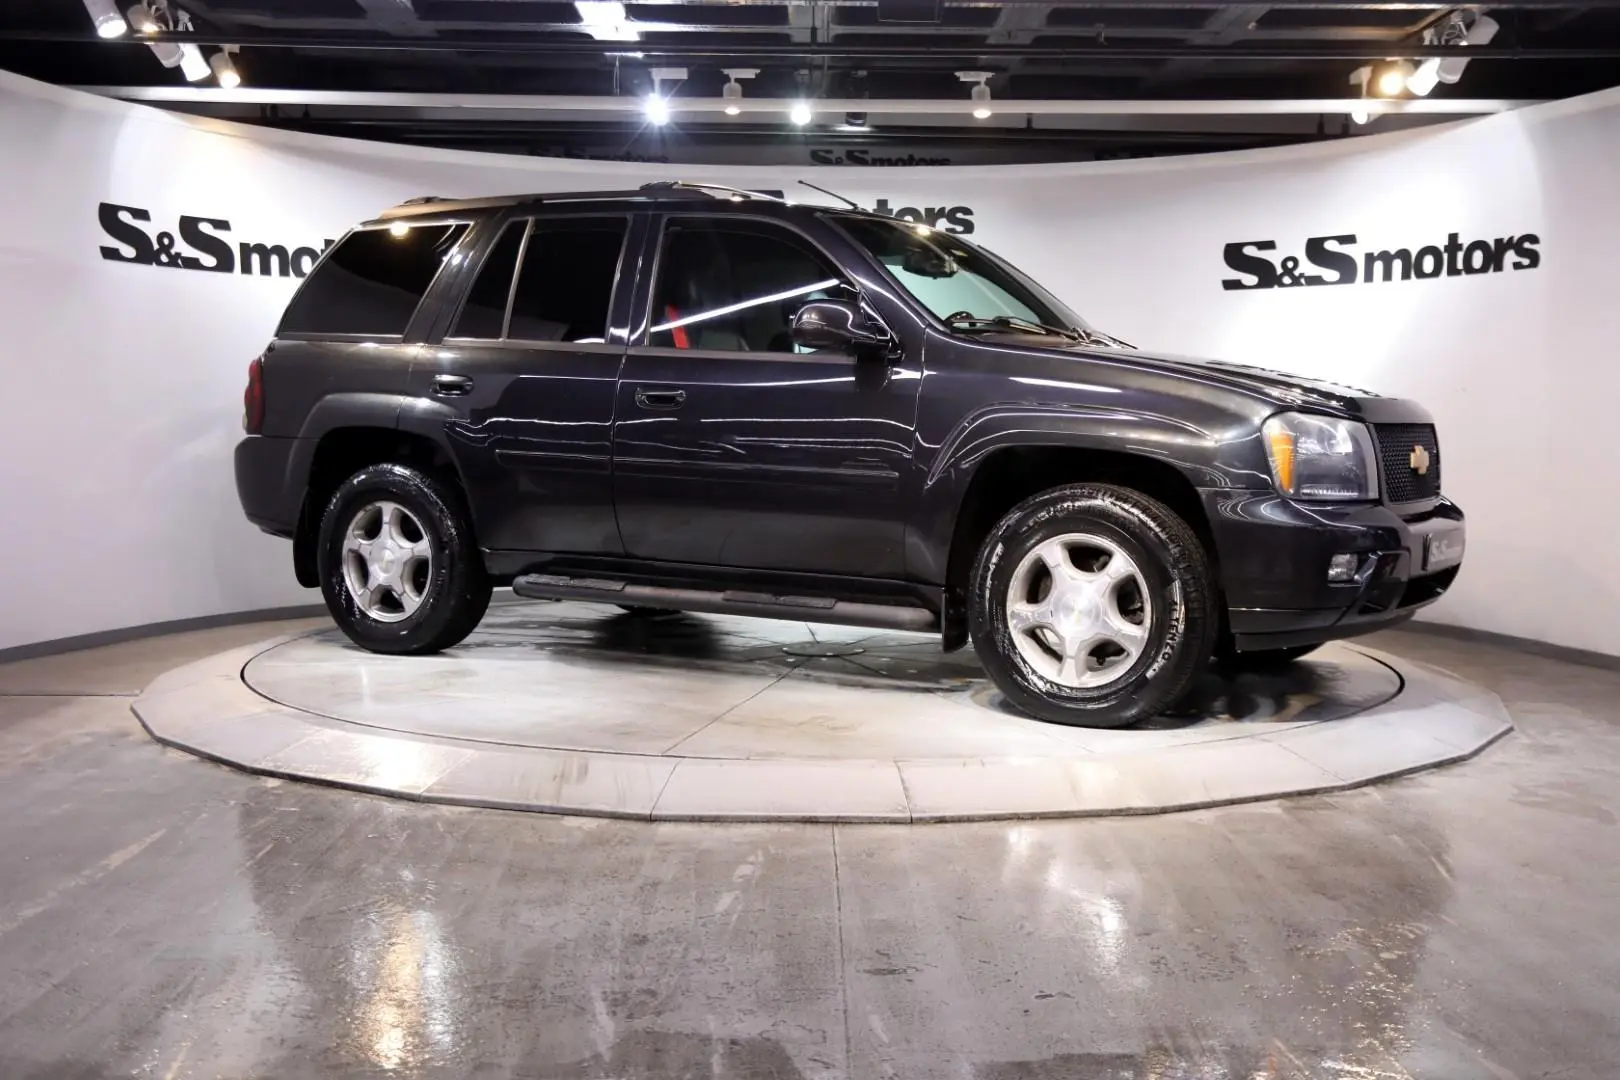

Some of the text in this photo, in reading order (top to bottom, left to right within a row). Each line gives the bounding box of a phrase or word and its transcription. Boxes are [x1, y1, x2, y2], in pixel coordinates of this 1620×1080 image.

[99, 202, 234, 273] S&S
[1222, 233, 1540, 290] S&S motors
